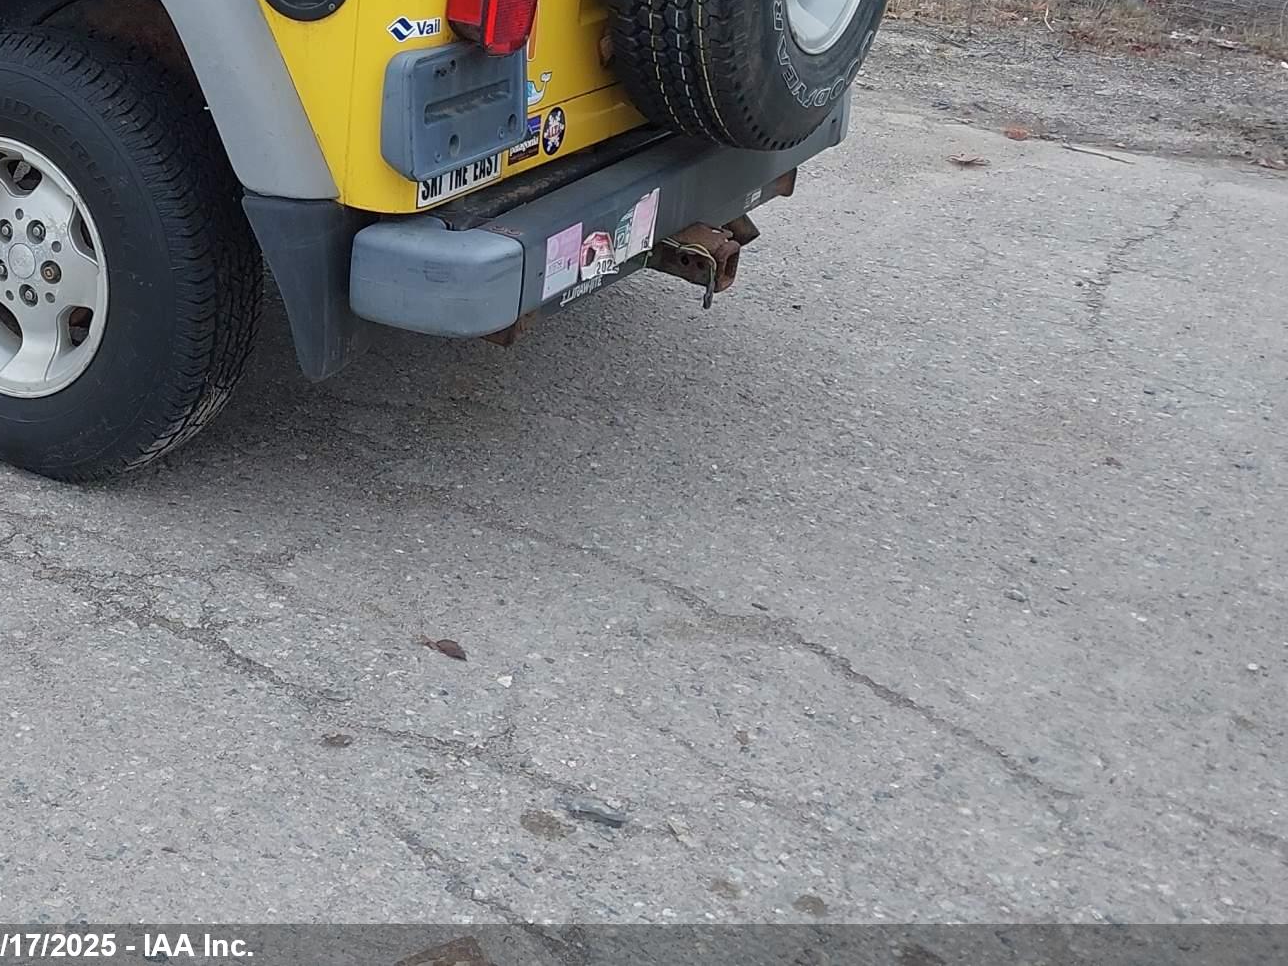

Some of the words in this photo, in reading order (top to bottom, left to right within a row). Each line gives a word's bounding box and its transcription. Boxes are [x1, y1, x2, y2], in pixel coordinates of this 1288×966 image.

[416, 19, 441, 35] Vail
[448, 166, 469, 191] THE
[472, 153, 499, 181] EAST
